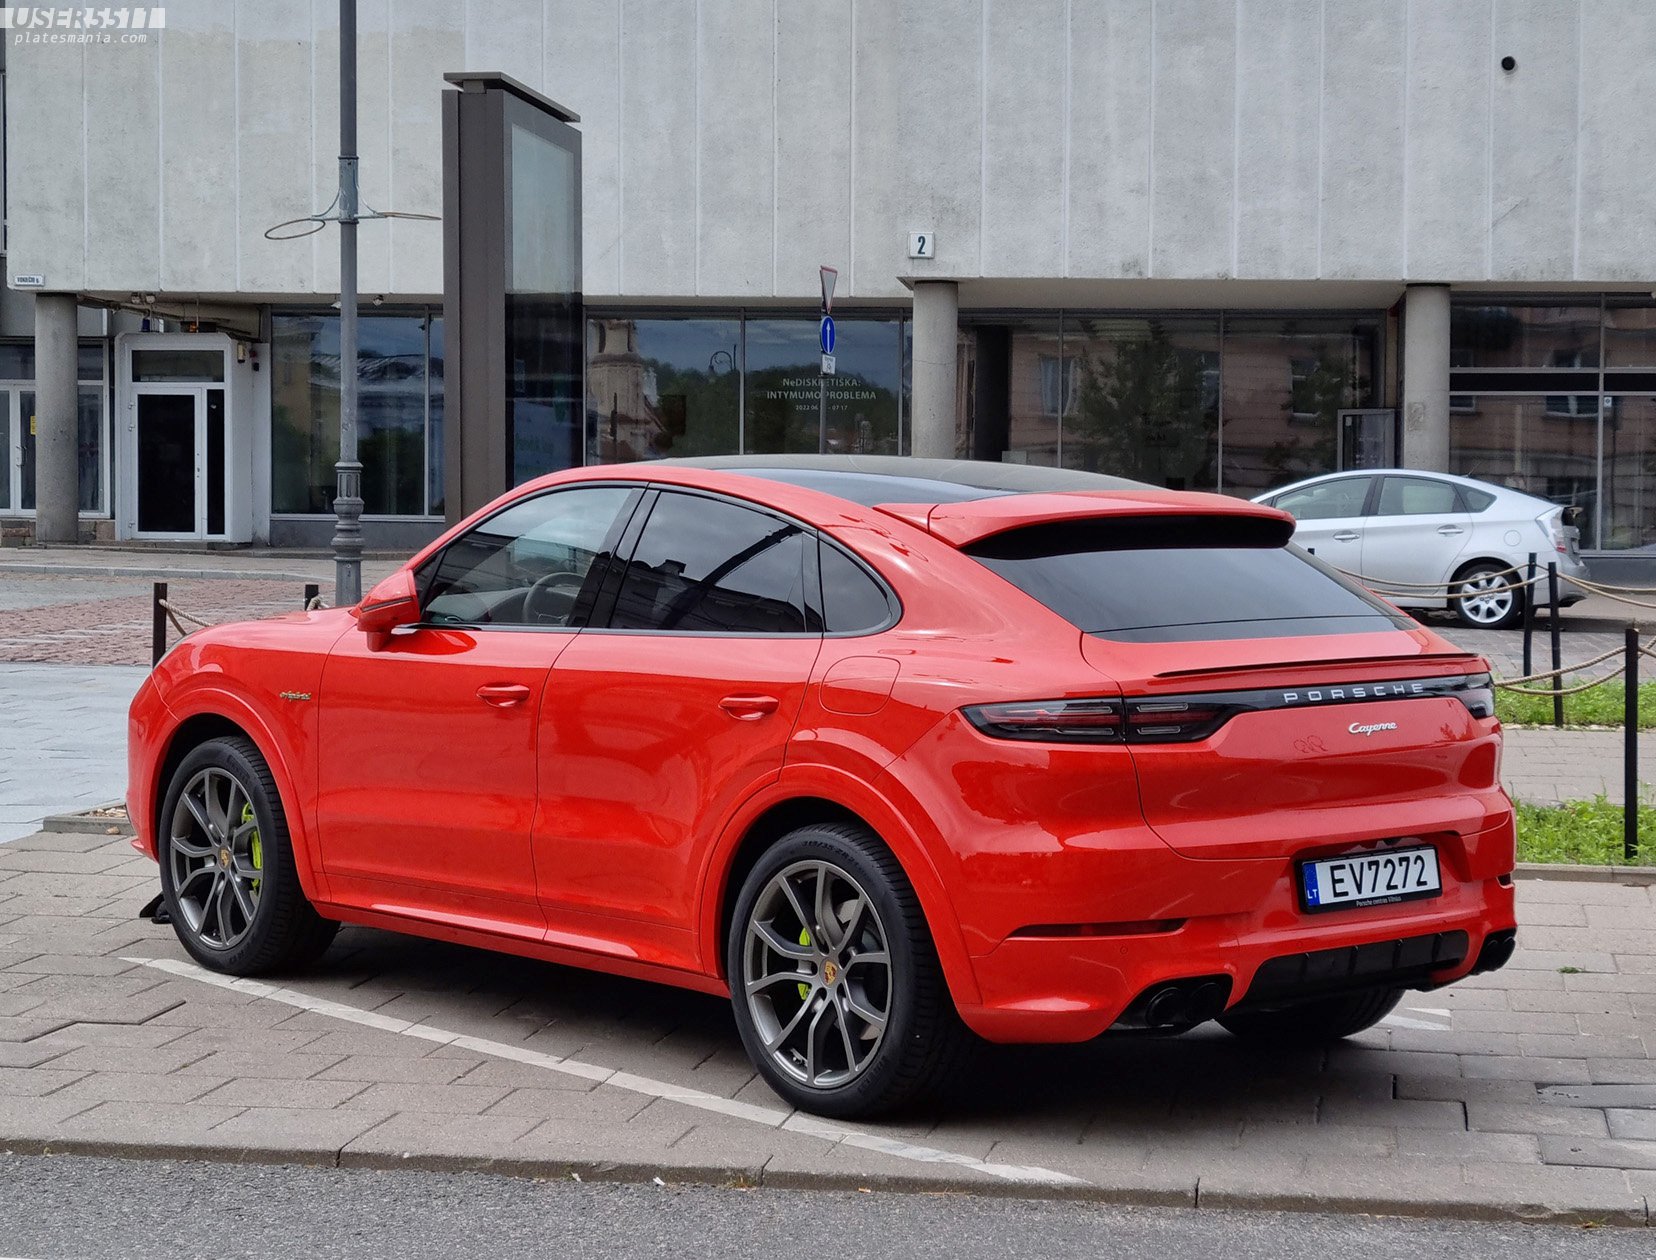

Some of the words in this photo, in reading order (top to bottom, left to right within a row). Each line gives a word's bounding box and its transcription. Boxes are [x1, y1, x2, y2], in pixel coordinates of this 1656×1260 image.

[917, 235, 926, 255] 2
[767, 390, 821, 400] INTYMUMO
[1283, 683, 1424, 703] PORSCHE
[1348, 721, 1398, 736] Cayenne
[1307, 889, 1318, 899] LT
[1330, 855, 1428, 898] EV7272
